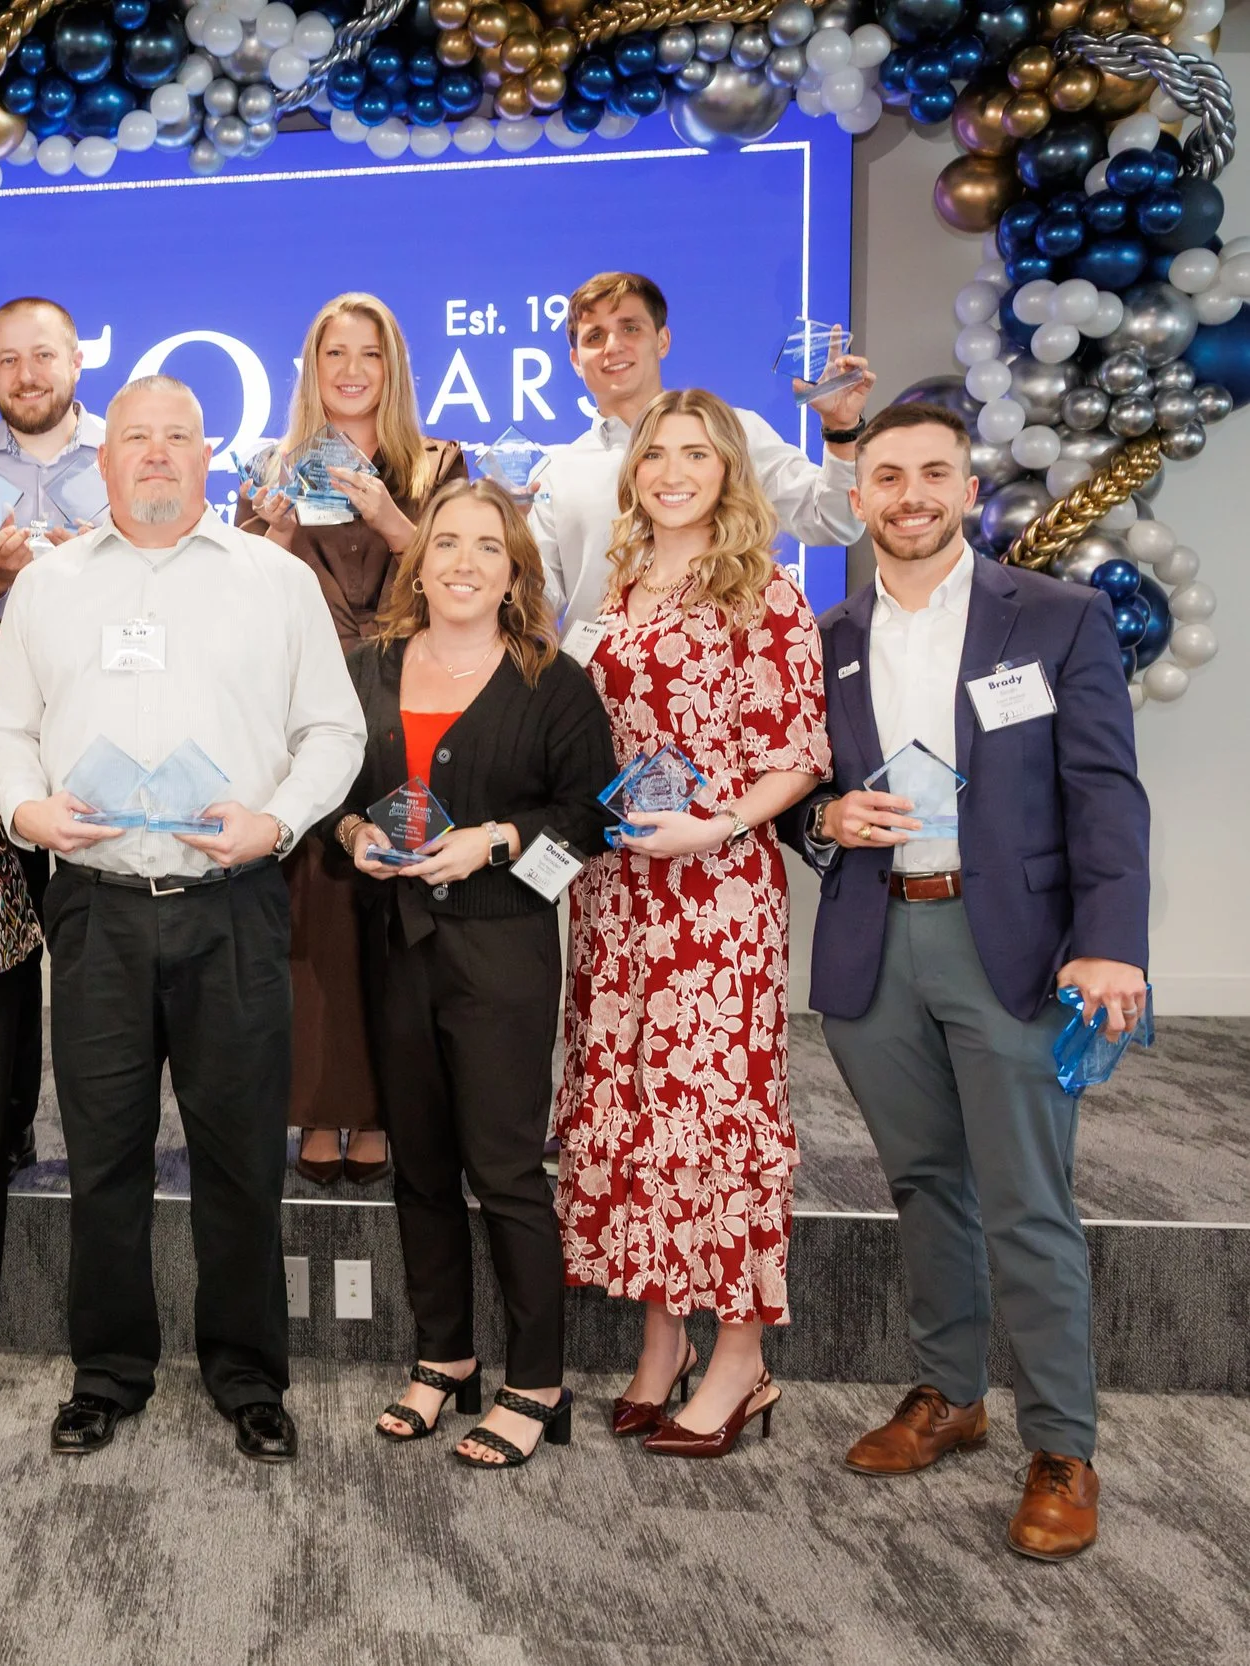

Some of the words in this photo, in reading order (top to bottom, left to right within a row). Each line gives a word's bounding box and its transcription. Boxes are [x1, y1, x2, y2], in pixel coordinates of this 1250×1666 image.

[446, 299, 506, 336] Est.
[526, 294, 570, 333] 19
[988, 674, 1023, 690] Brady
[390, 801, 412, 809] Annual
[411, 805, 432, 814] Awards
[545, 843, 570, 866] Denise
